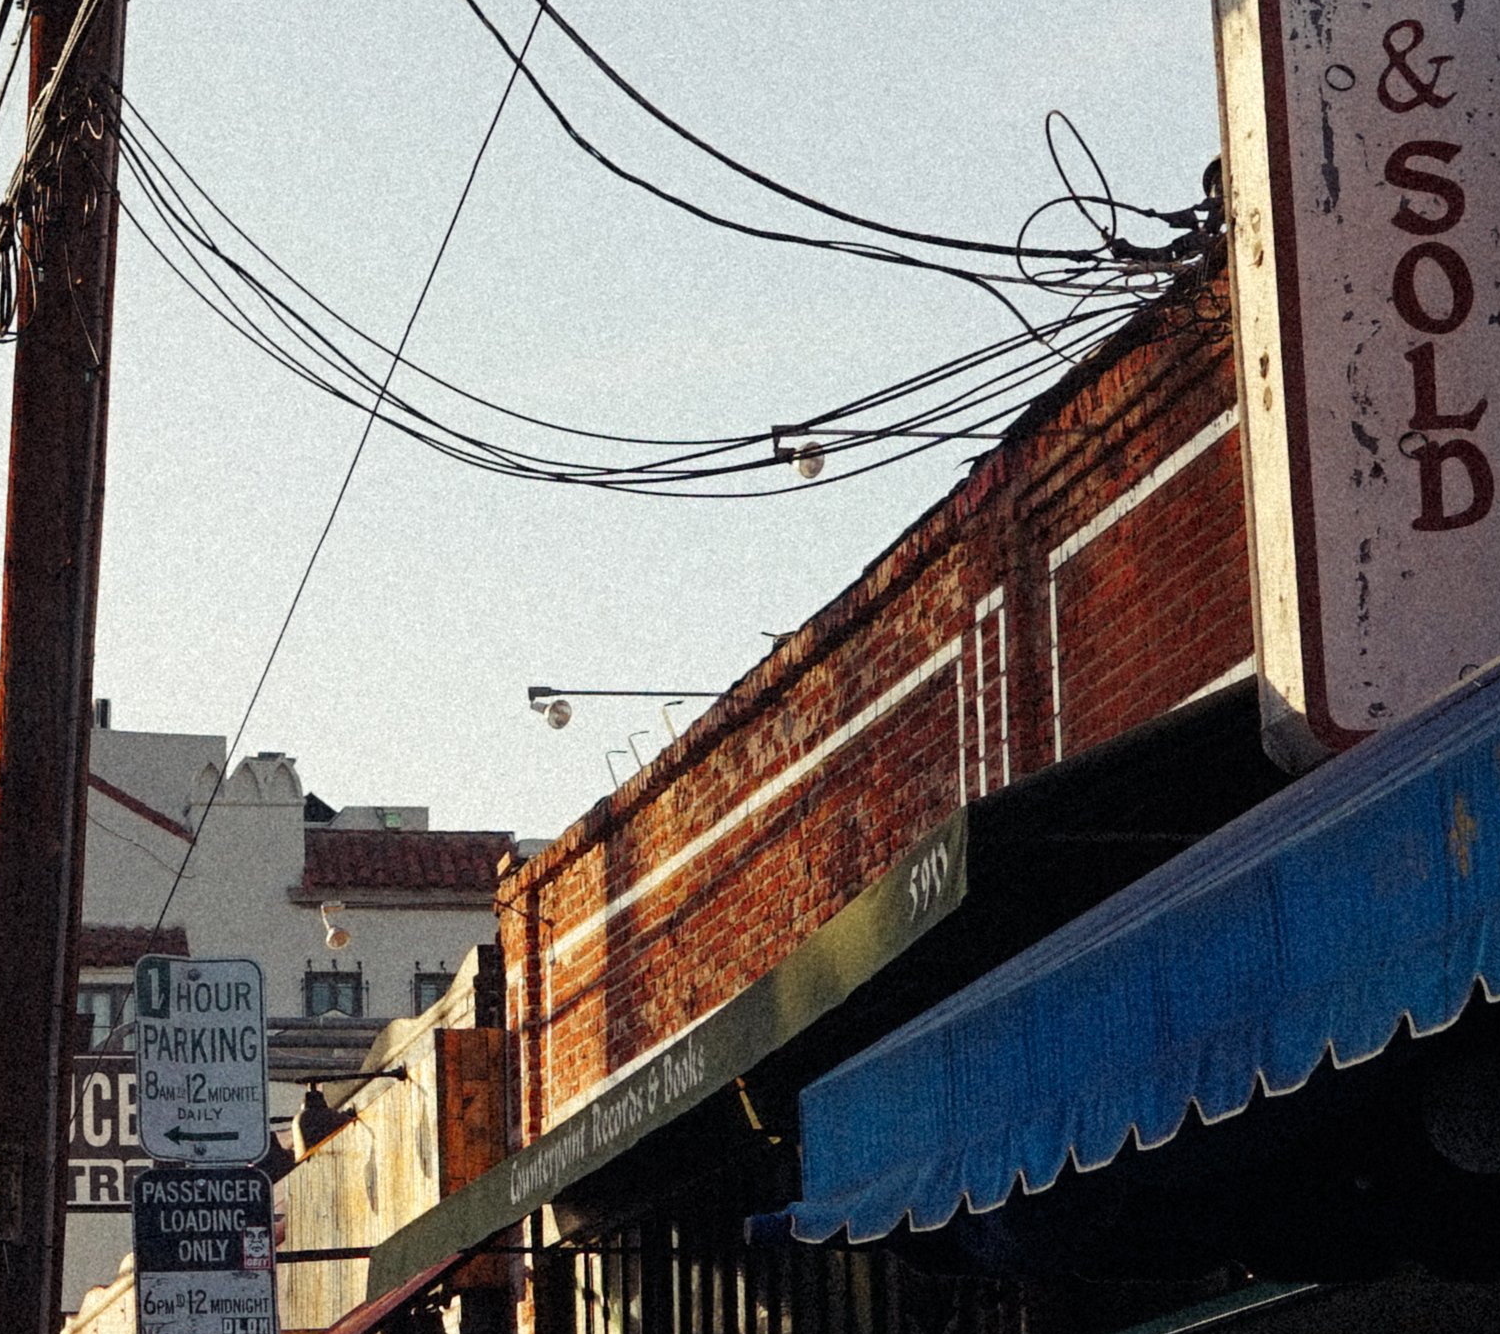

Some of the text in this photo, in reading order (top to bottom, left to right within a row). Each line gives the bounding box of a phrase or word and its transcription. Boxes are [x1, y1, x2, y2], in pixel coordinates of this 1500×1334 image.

[1377, 18, 1456, 113] &
[1386, 140, 1497, 534] SOLD
[177, 981, 252, 1013] HOUR
[143, 1024, 258, 1064] PARKING
[207, 1085, 260, 1103] MIDNITE
[177, 1107, 224, 1121] DAILY
[510, 1120, 587, 1206] Counterpoint
[591, 1085, 644, 1151] Records
[663, 1033, 705, 1104] Books
[142, 1179, 262, 1204] PASSENGER
[160, 1209, 246, 1233] LOADING
[178, 1238, 230, 1263] ONLY
[143, 1290, 175, 1316] 6PM
[210, 1297, 270, 1315] MIDNIGHT
